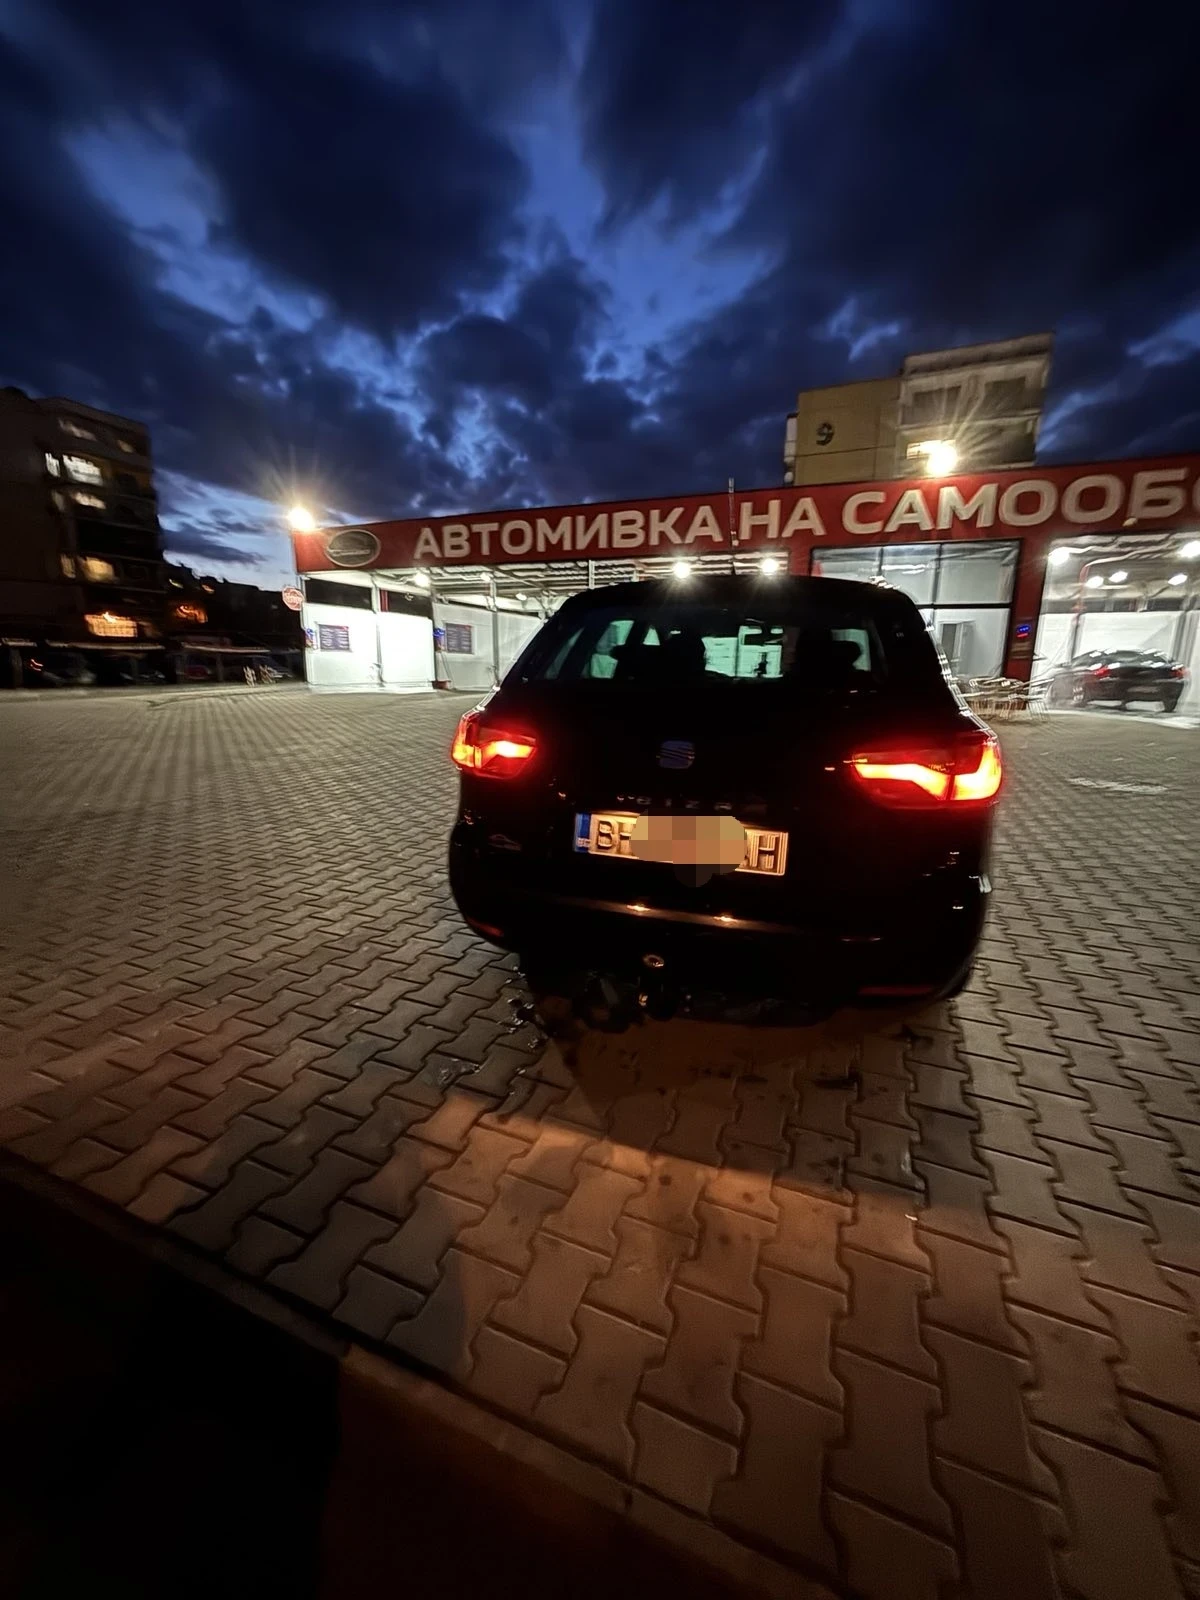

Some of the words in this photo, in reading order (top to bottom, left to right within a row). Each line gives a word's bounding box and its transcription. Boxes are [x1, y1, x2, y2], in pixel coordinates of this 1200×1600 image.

[815, 422, 835, 447] 9
[413, 504, 724, 559] АВТОМИВКА
[739, 497, 827, 540] НА
[841, 467, 1200, 534] САМООБ
